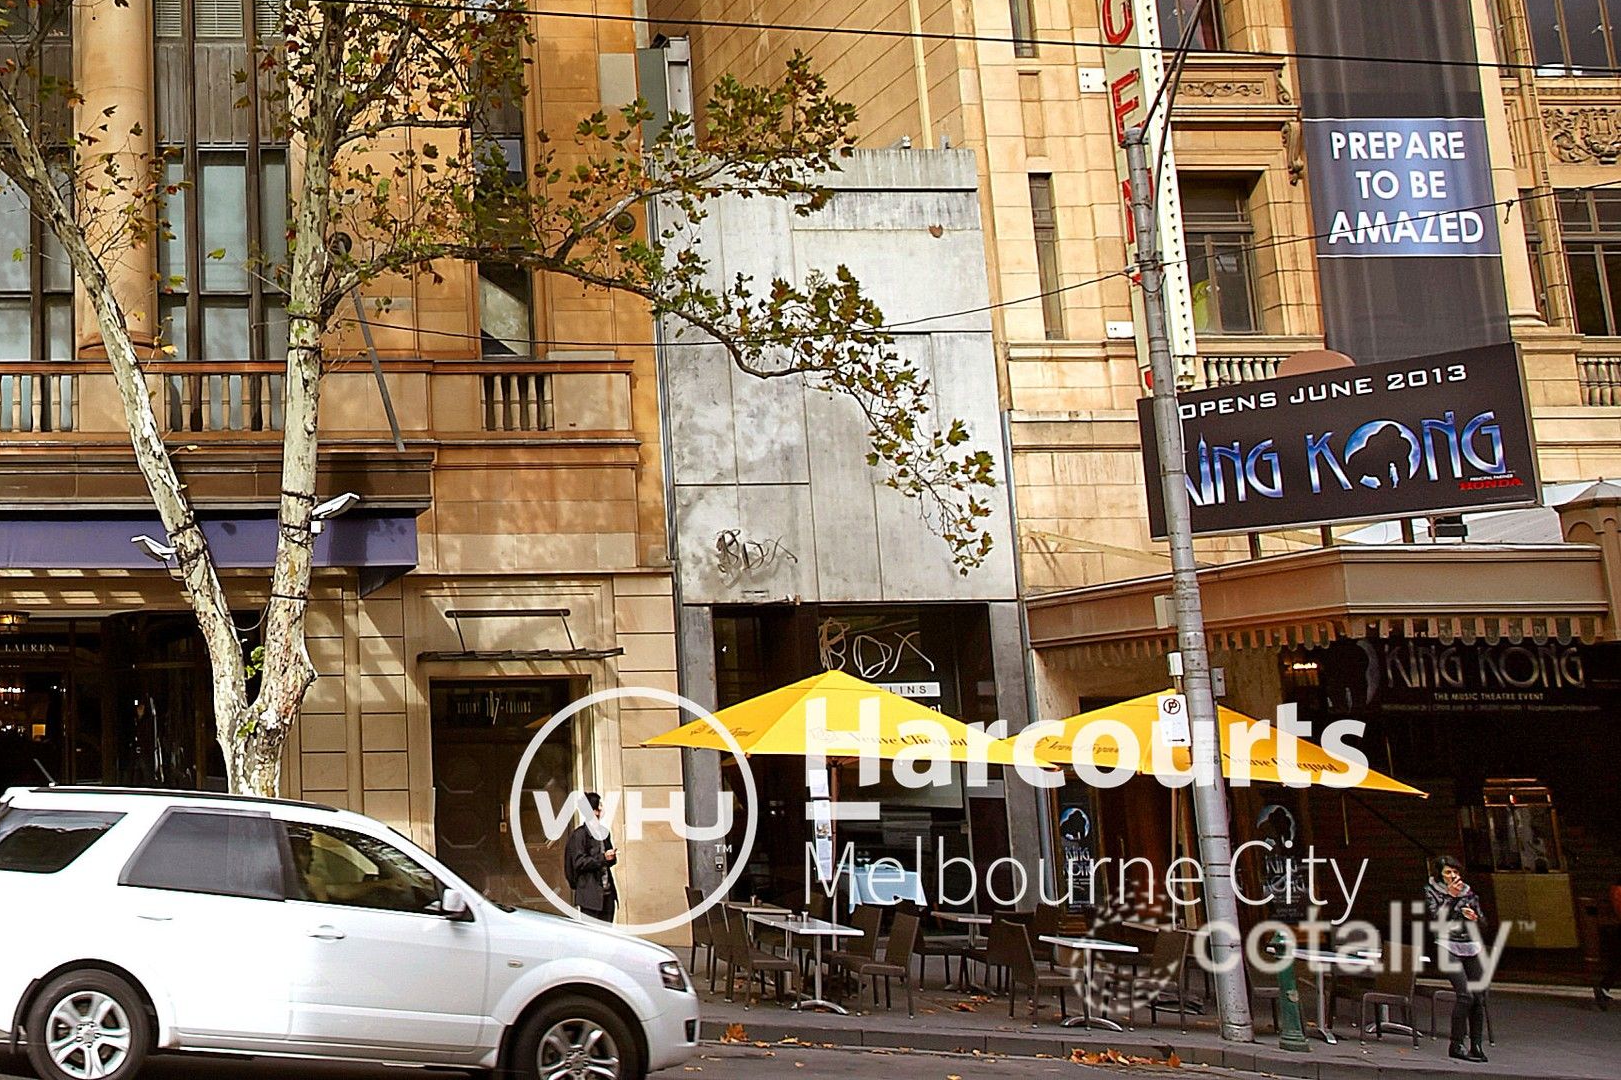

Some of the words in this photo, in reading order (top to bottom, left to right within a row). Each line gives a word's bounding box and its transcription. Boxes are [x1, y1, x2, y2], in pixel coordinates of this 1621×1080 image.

[1331, 130, 1465, 161] PREPARE
[1355, 169, 1399, 199] TO
[1410, 169, 1447, 198] BE
[1328, 210, 1486, 246] AMAZED
[1179, 390, 1278, 420] OPENS
[1289, 376, 1374, 405] JUNE
[1386, 364, 1468, 391] 2013
[1459, 478, 1523, 490] HONDA
[5, 643, 55, 652] LAUREN
[1384, 640, 1464, 688] KING
[1477, 642, 1586, 689] KONG
[1434, 693, 1450, 701] THE
[1480, 693, 1516, 701] THEATRE
[1518, 693, 1544, 701] EVENT
